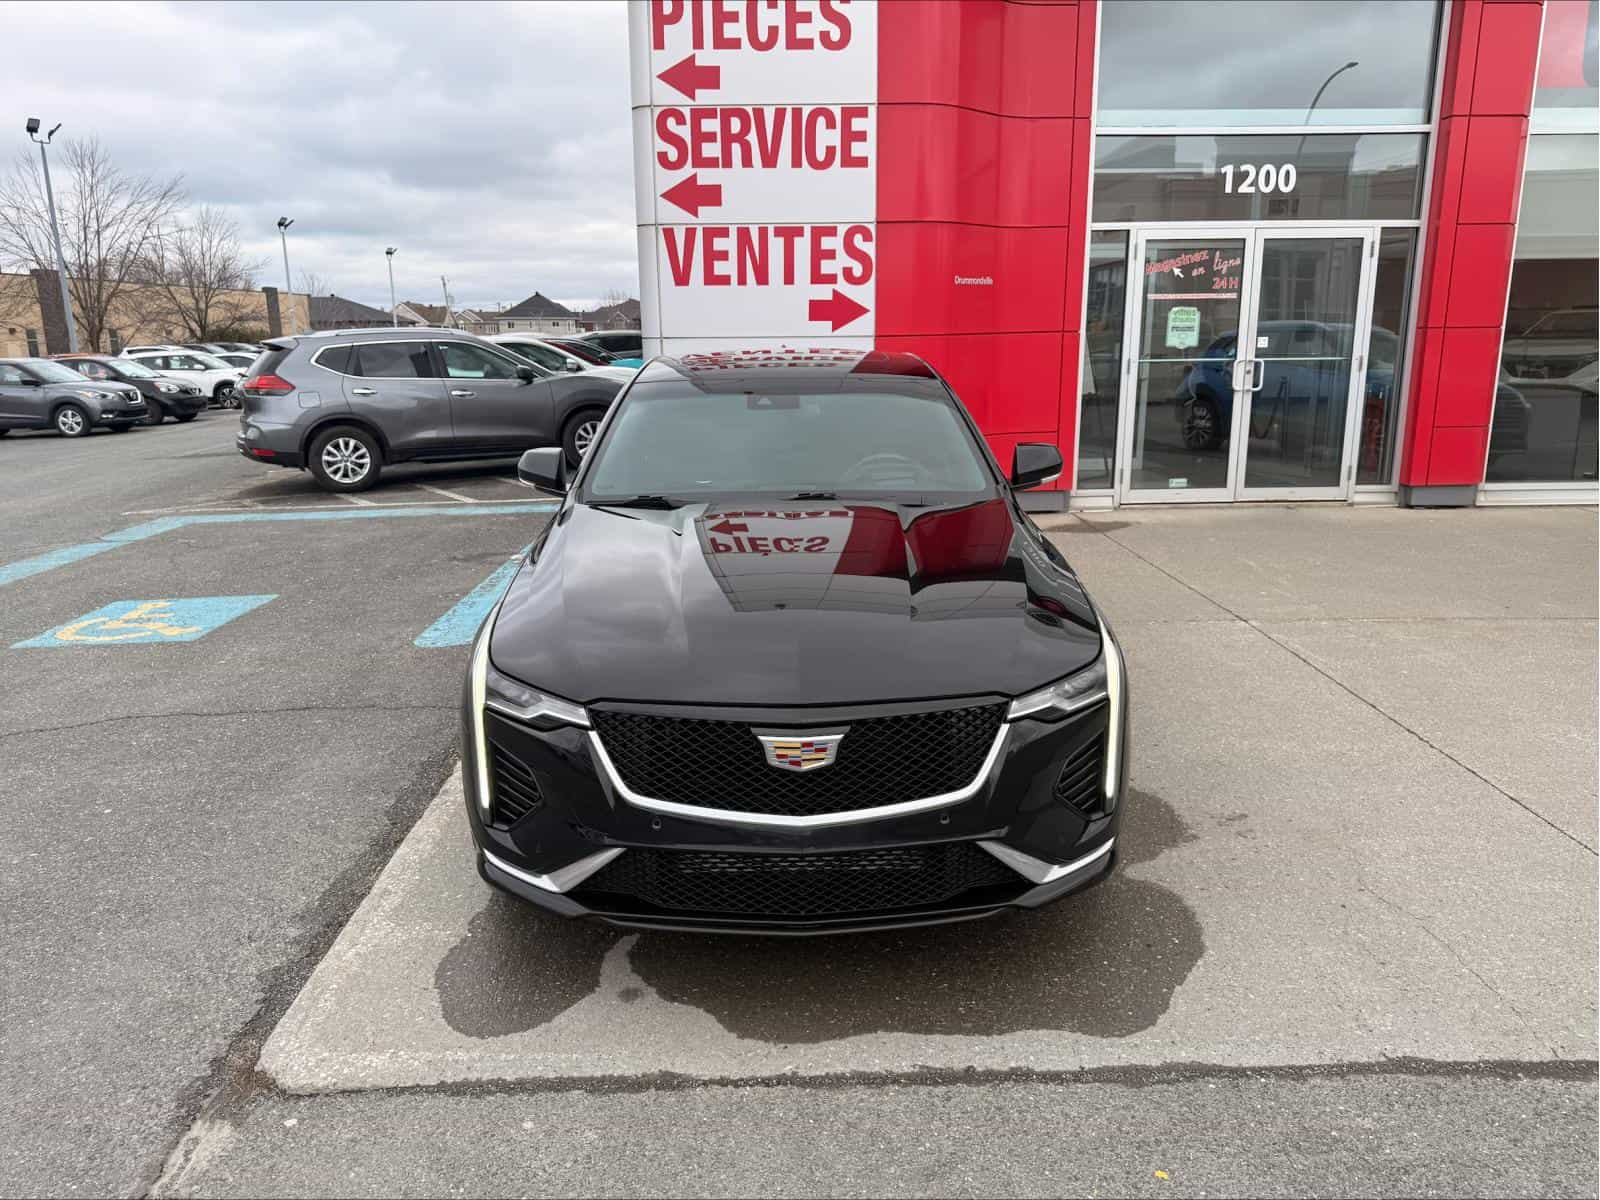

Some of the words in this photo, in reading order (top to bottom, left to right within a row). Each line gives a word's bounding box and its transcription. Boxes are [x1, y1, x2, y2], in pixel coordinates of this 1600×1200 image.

[656, 106, 869, 171] SERVICE
[1221, 163, 1297, 194] 1200
[663, 225, 874, 287] VENTES
[954, 275, 994, 285] Drummondville
